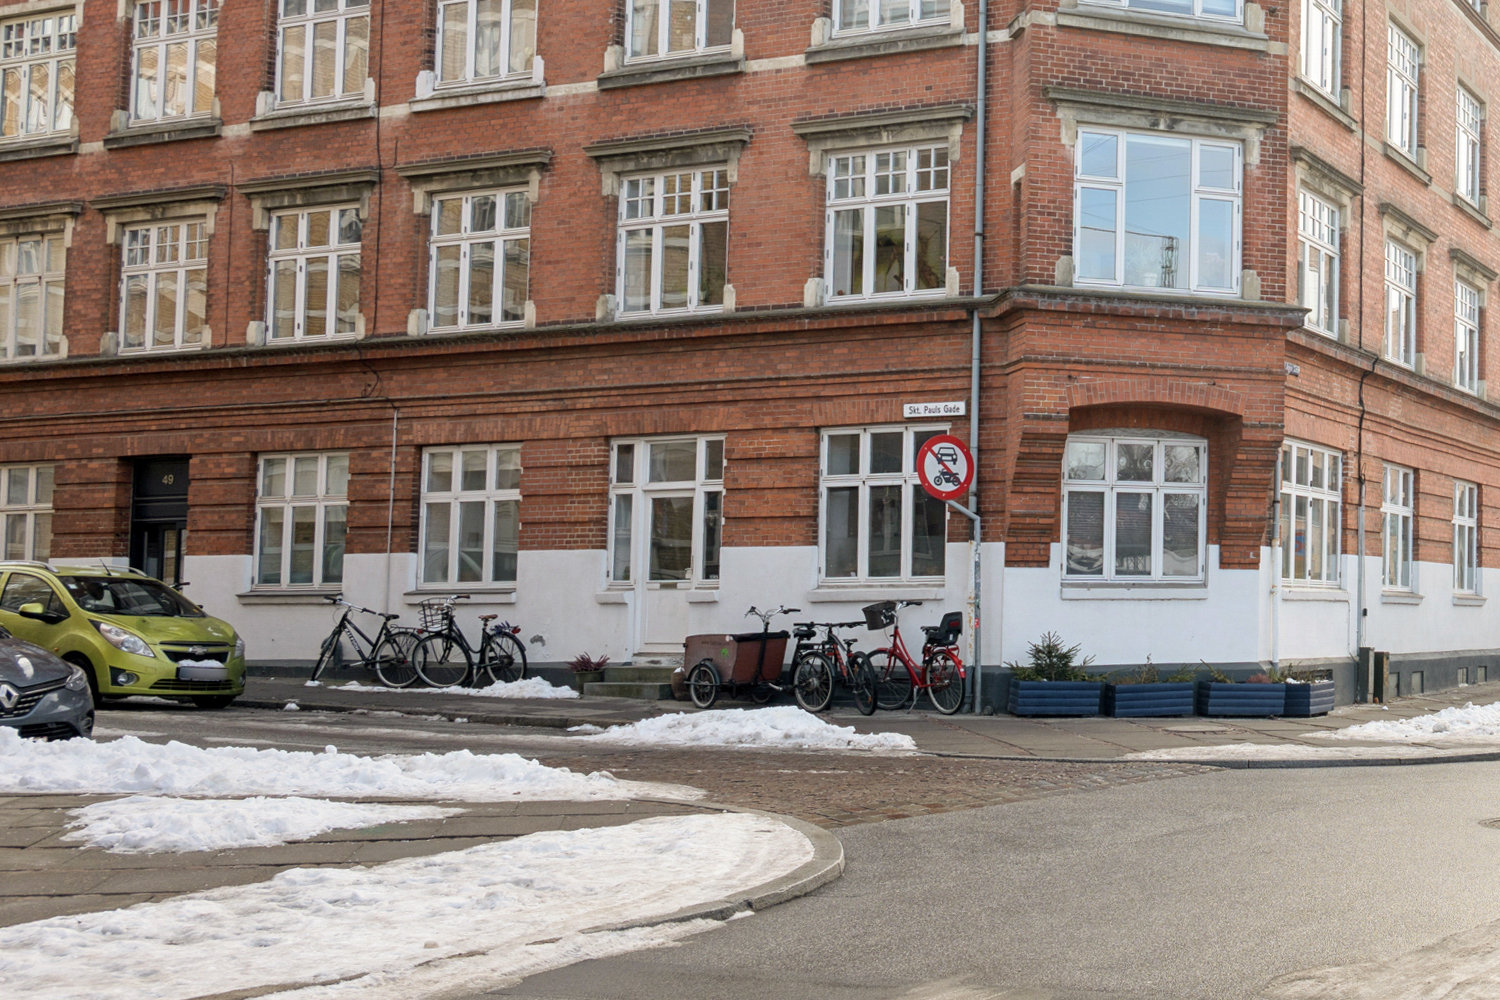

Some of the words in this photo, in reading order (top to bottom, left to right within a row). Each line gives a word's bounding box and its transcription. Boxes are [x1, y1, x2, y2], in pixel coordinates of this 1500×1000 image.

[908, 406, 921, 415] Skt.
[924, 405, 941, 414] Pauls
[943, 404, 960, 413] Gade
[161, 474, 174, 485] 49
